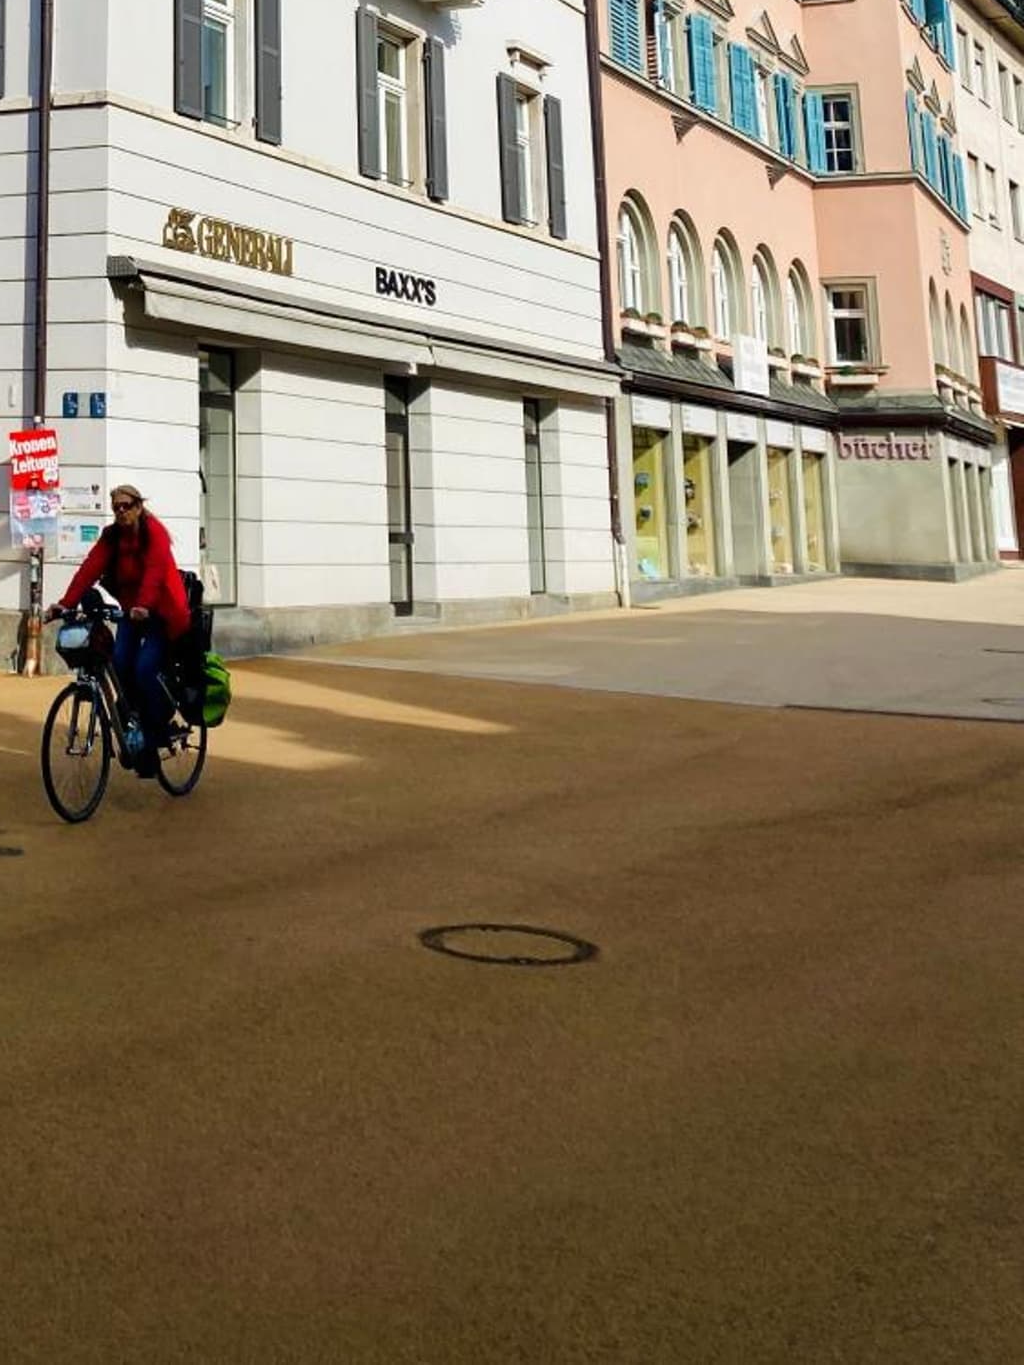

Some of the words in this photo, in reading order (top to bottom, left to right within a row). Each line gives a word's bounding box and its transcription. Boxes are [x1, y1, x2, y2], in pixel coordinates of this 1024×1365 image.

[197, 217, 294, 276] GENERALI
[376, 266, 436, 305] BAXX'S
[10, 437, 56, 455] Kronen
[12, 455, 58, 475] Zeitung
